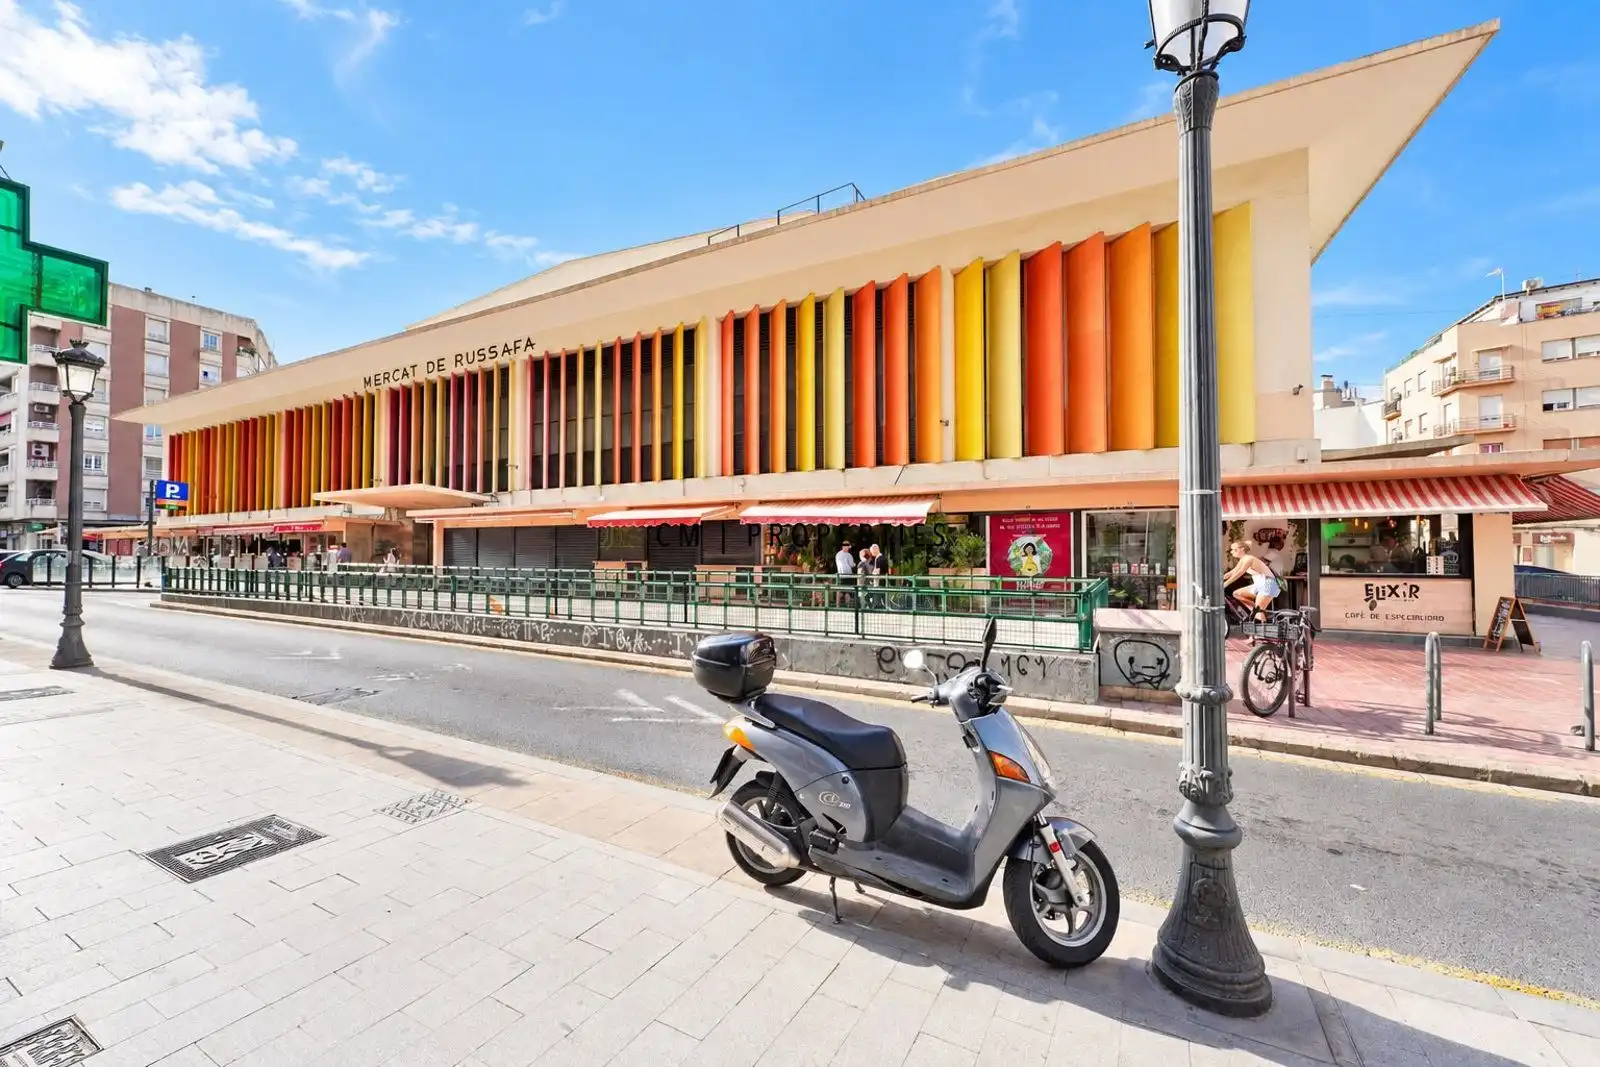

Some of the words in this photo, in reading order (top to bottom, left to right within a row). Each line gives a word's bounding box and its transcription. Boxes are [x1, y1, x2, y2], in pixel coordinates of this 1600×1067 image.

[363, 364, 418, 388] MERCAT
[426, 358, 446, 374] DE
[454, 336, 536, 368] RUSSAFA
